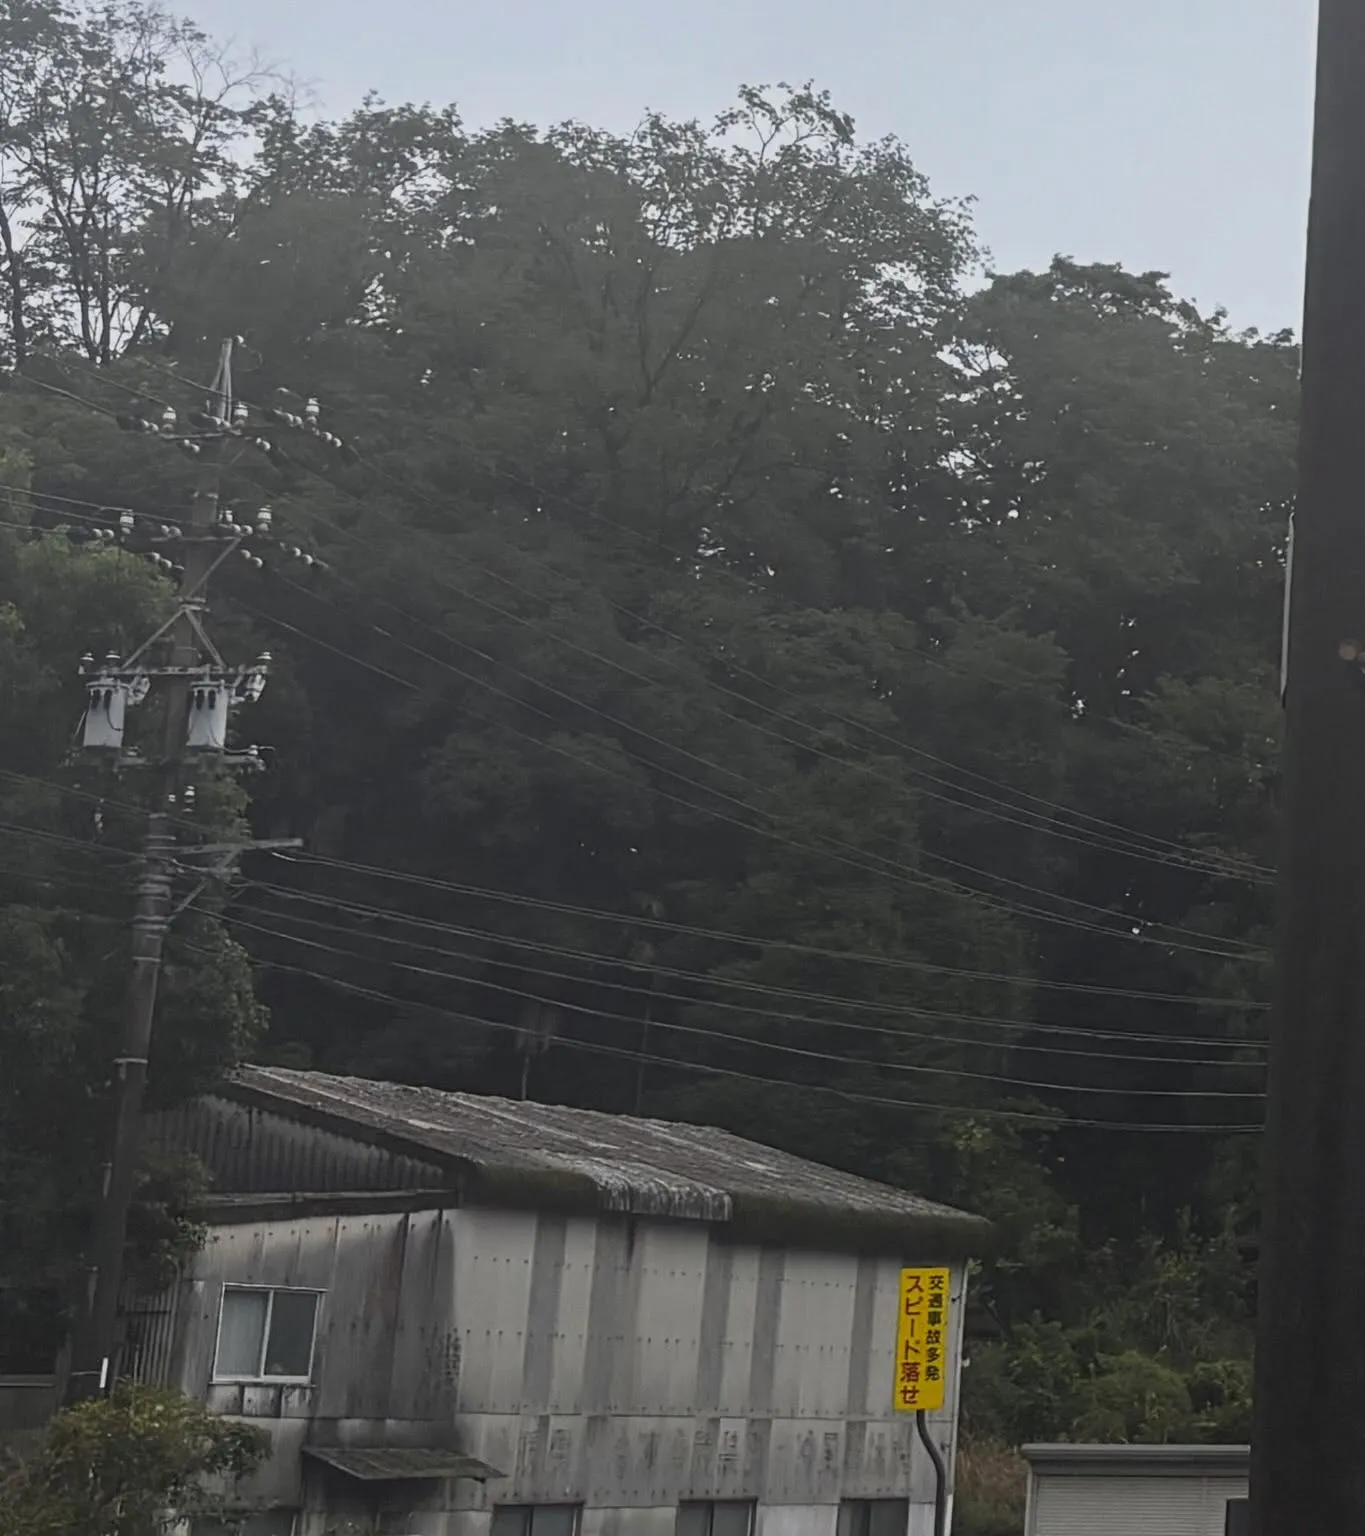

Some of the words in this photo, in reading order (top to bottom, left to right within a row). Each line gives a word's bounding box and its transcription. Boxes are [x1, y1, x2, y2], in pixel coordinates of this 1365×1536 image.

[900, 1275, 924, 1404] スピード落せ
[924, 1275, 944, 1381] 交通事故多発
